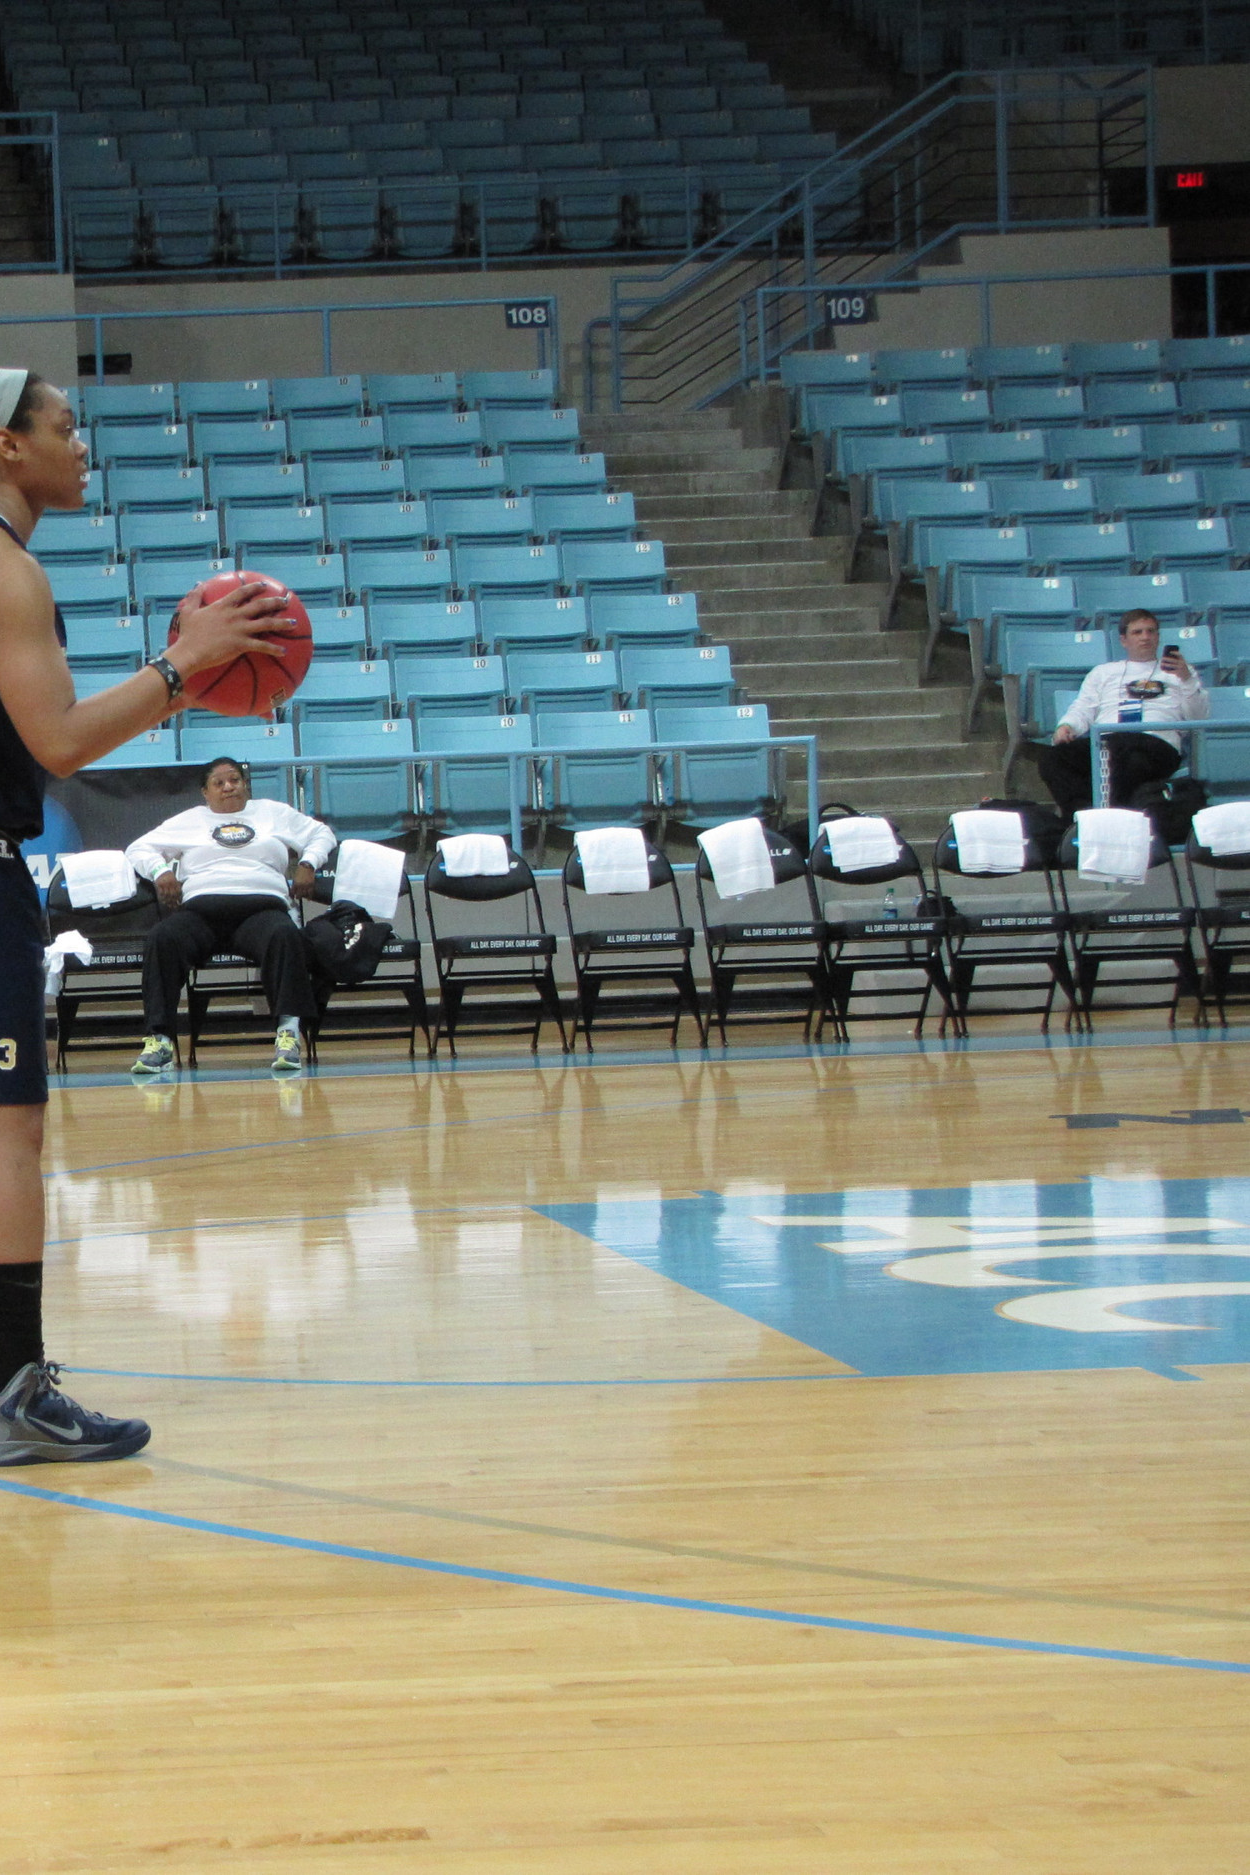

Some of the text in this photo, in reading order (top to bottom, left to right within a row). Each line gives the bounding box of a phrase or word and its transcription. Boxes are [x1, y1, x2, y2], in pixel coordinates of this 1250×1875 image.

[827, 297, 864, 319] 109
[508, 307, 546, 324] 108
[340, 377, 348, 385] 10
[434, 375, 442, 383] 11
[555, 411, 564, 419] 12
[360, 419, 369, 428] 10
[581, 456, 590, 464] 12
[380, 463, 390, 471] 10
[609, 495, 619, 504] 12
[402, 504, 411, 512] 10
[508, 500, 516, 509] 11
[533, 549, 541, 557] 11
[638, 544, 648, 553] 12
[426, 553, 435, 561] 10
[559, 600, 568, 609] 11
[670, 596, 680, 605] 12
[449, 605, 459, 614] 10
[703, 650, 712, 659] 12
[476, 659, 486, 668] 10
[589, 655, 598, 664] 11
[740, 708, 750, 717] 12
[504, 717, 514, 727] 10
[622, 713, 631, 723] 11
[607, 935, 615, 943] ALL
[652, 933, 662, 941] OUR
[470, 941, 479, 949] ALL
